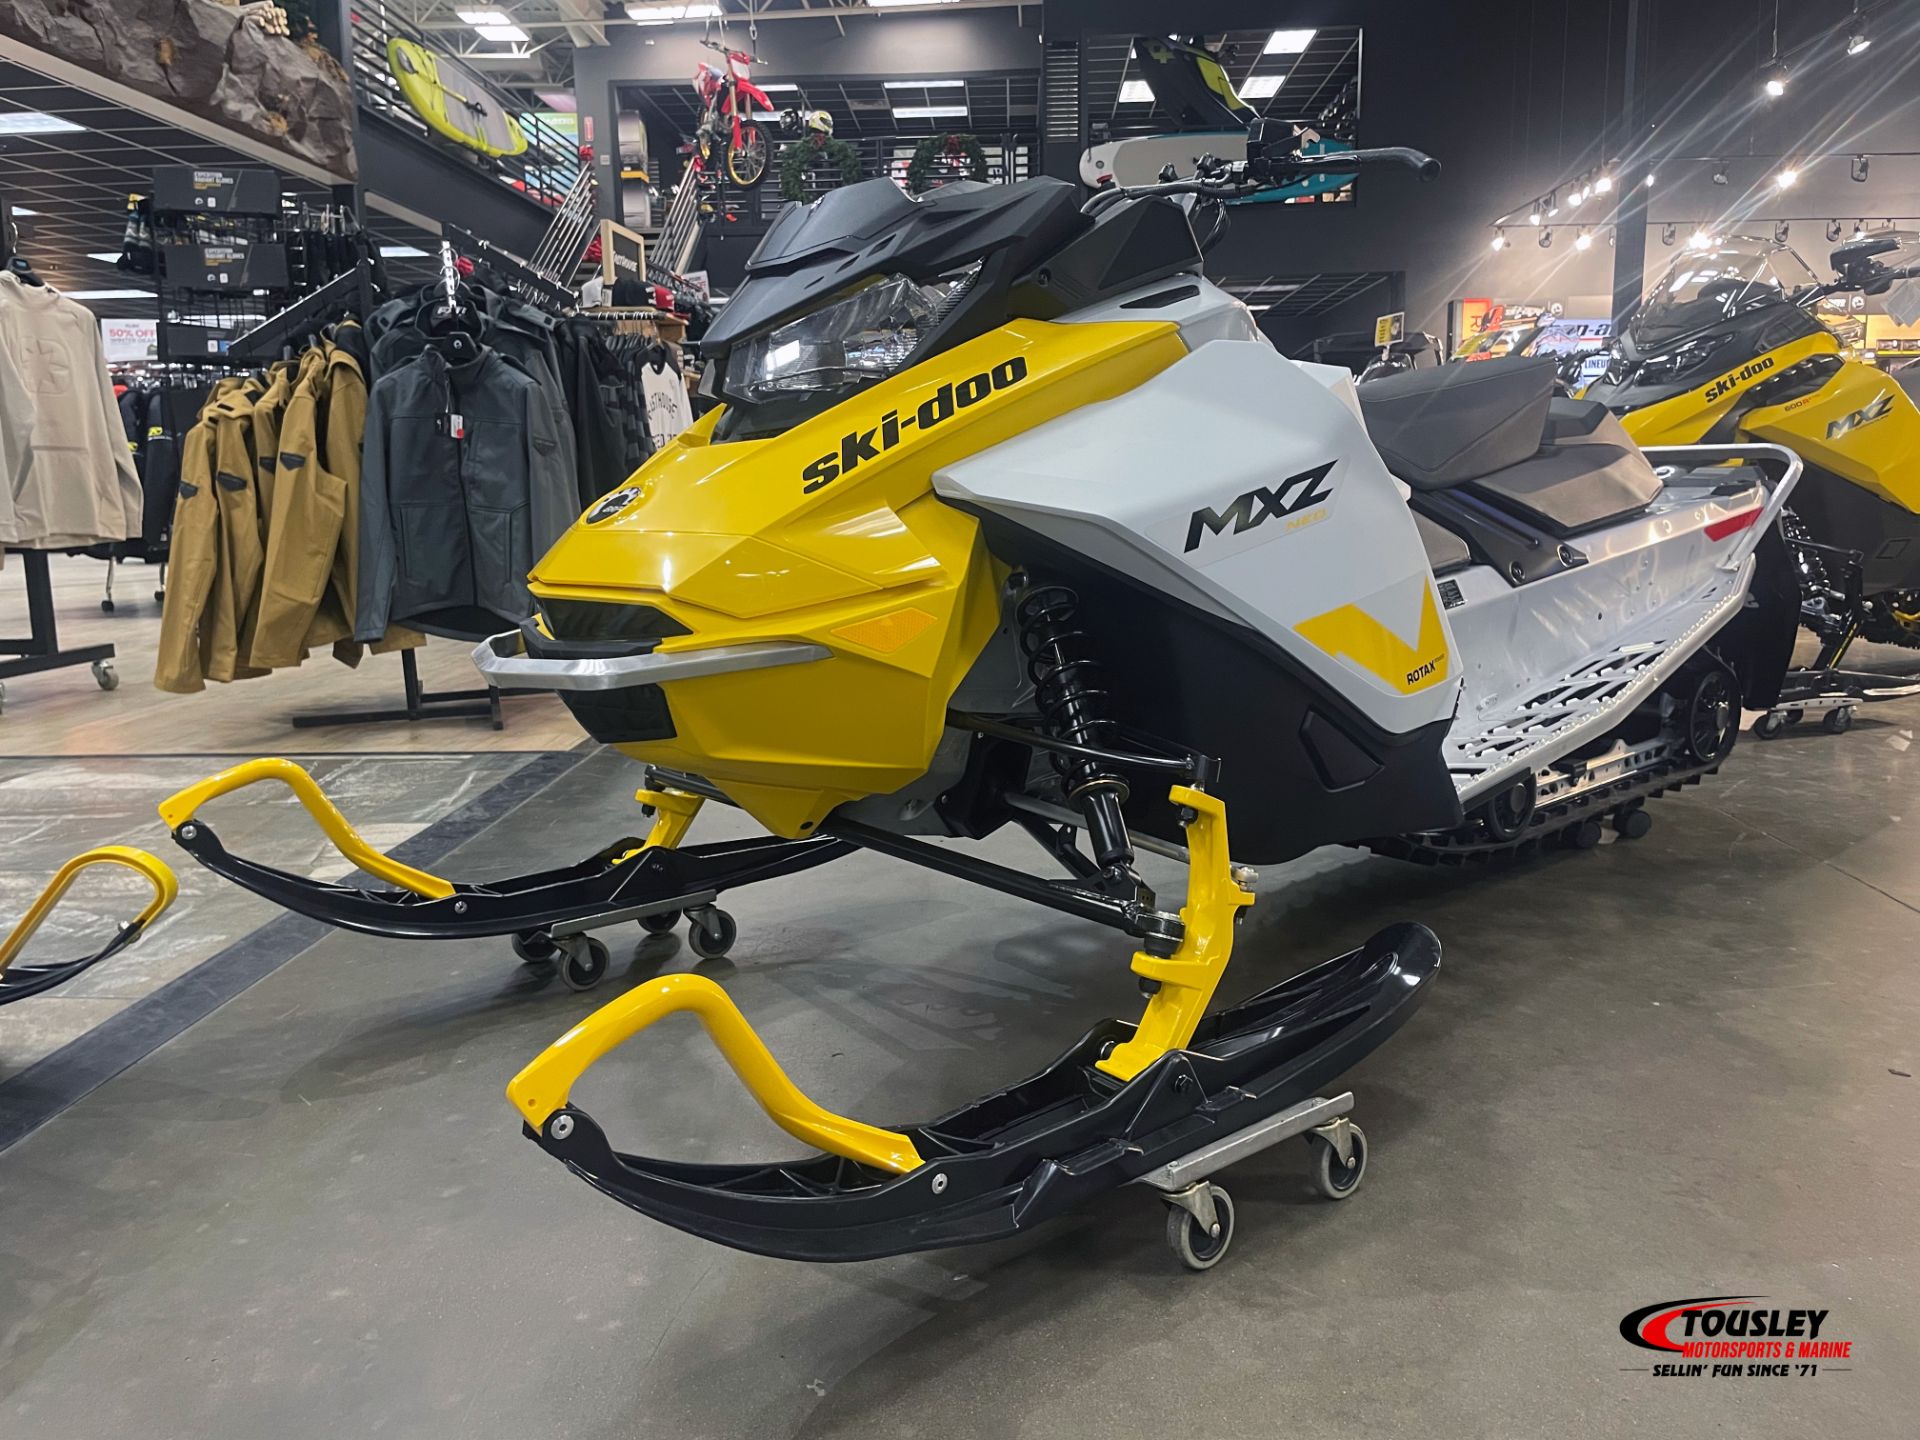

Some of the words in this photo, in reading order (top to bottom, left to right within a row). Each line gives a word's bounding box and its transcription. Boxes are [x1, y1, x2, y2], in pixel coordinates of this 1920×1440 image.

[109, 329, 133, 337] 50%
[135, 329, 155, 337] OFF
[1704, 357, 1775, 404] ski-doo
[802, 356, 1028, 495] ski-doo
[1826, 394, 1896, 440] MXZ
[1183, 458, 1340, 554] MXZ
[1285, 507, 1329, 532] NEO
[1406, 660, 1436, 686] ROTAX
